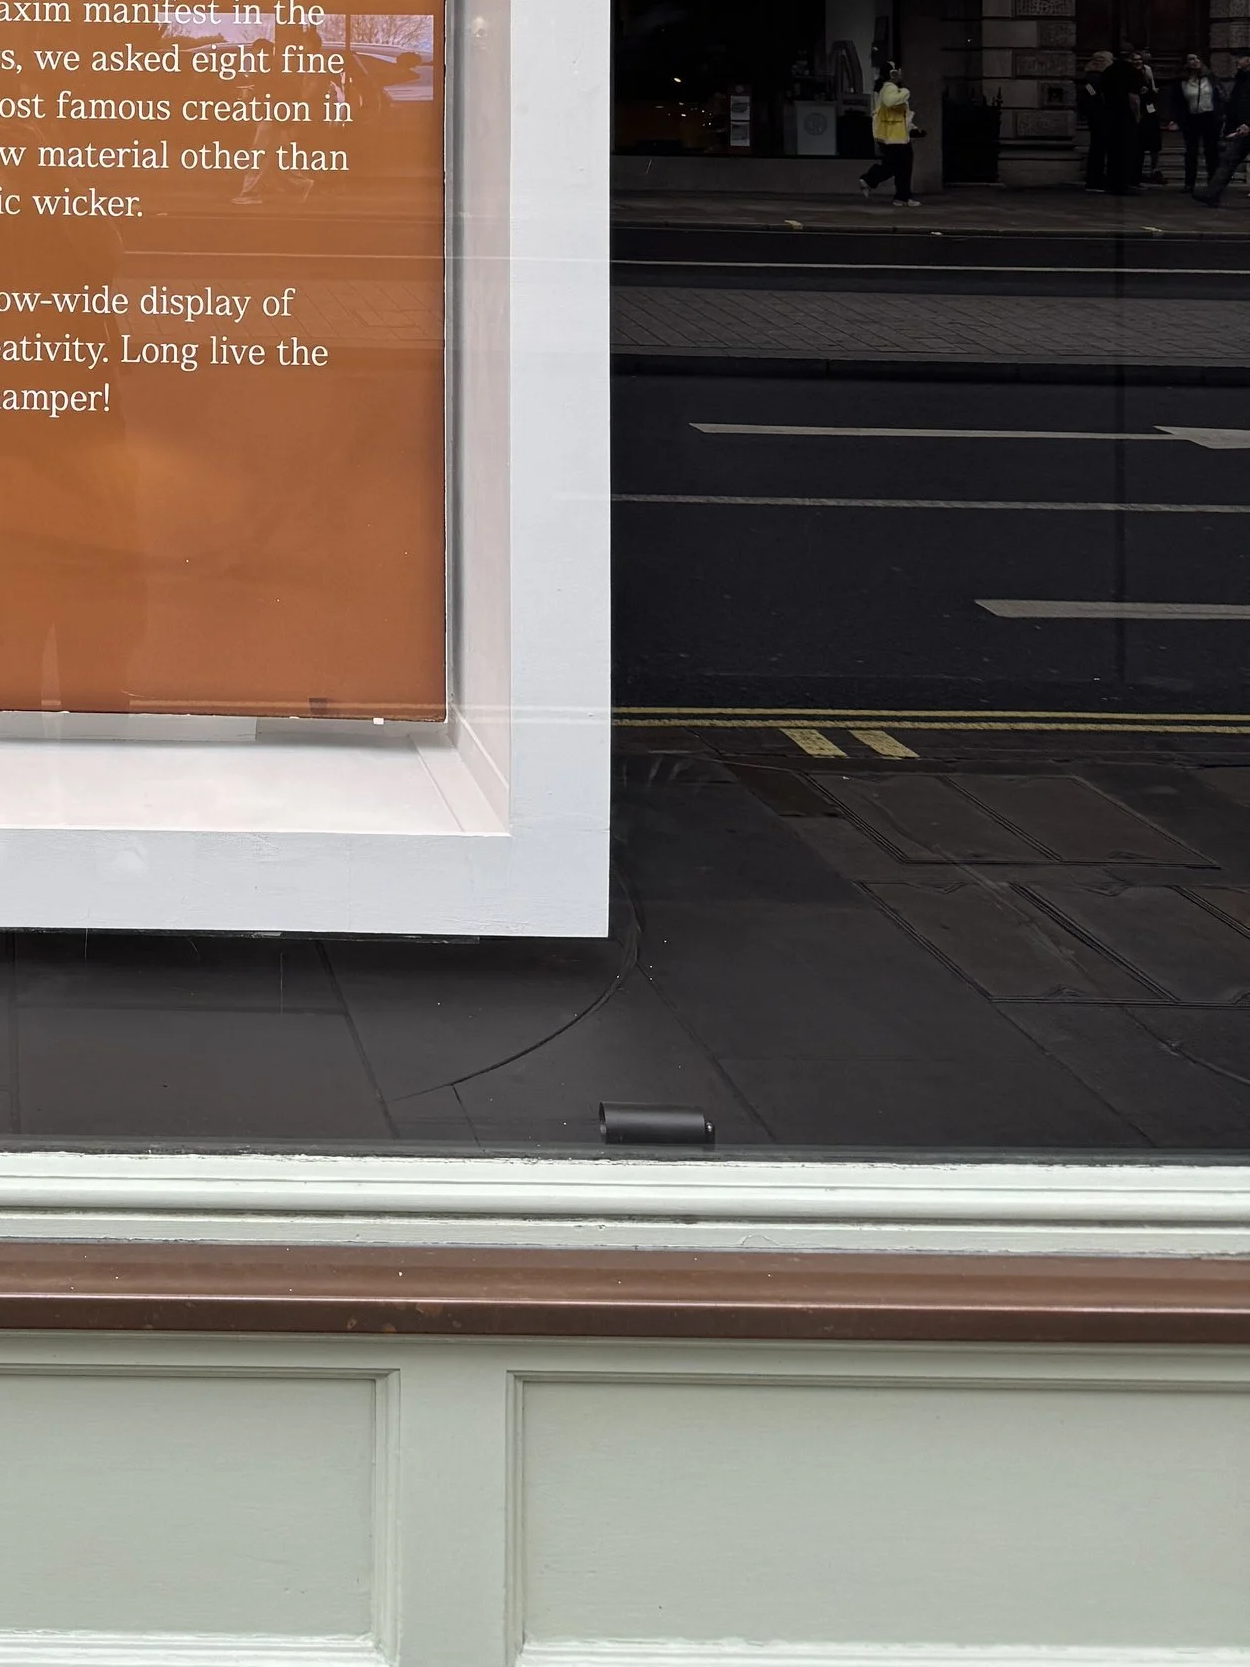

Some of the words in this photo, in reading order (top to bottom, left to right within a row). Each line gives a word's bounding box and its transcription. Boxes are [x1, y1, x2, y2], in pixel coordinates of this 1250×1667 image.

[33, 50, 80, 71] we
[91, 43, 182, 73] asked
[192, 44, 271, 81] eight
[281, 44, 345, 74] fine
[56, 90, 171, 121] famous
[182, 93, 312, 122] creation
[323, 92, 355, 123] in
[37, 139, 169, 169] material
[180, 140, 266, 170] other
[275, 141, 350, 171] than
[32, 187, 143, 218] wicker.
[140, 285, 252, 324] display
[262, 287, 296, 317] of
[120, 334, 199, 372] Long
[210, 335, 266, 366] live
[276, 336, 329, 367] the
